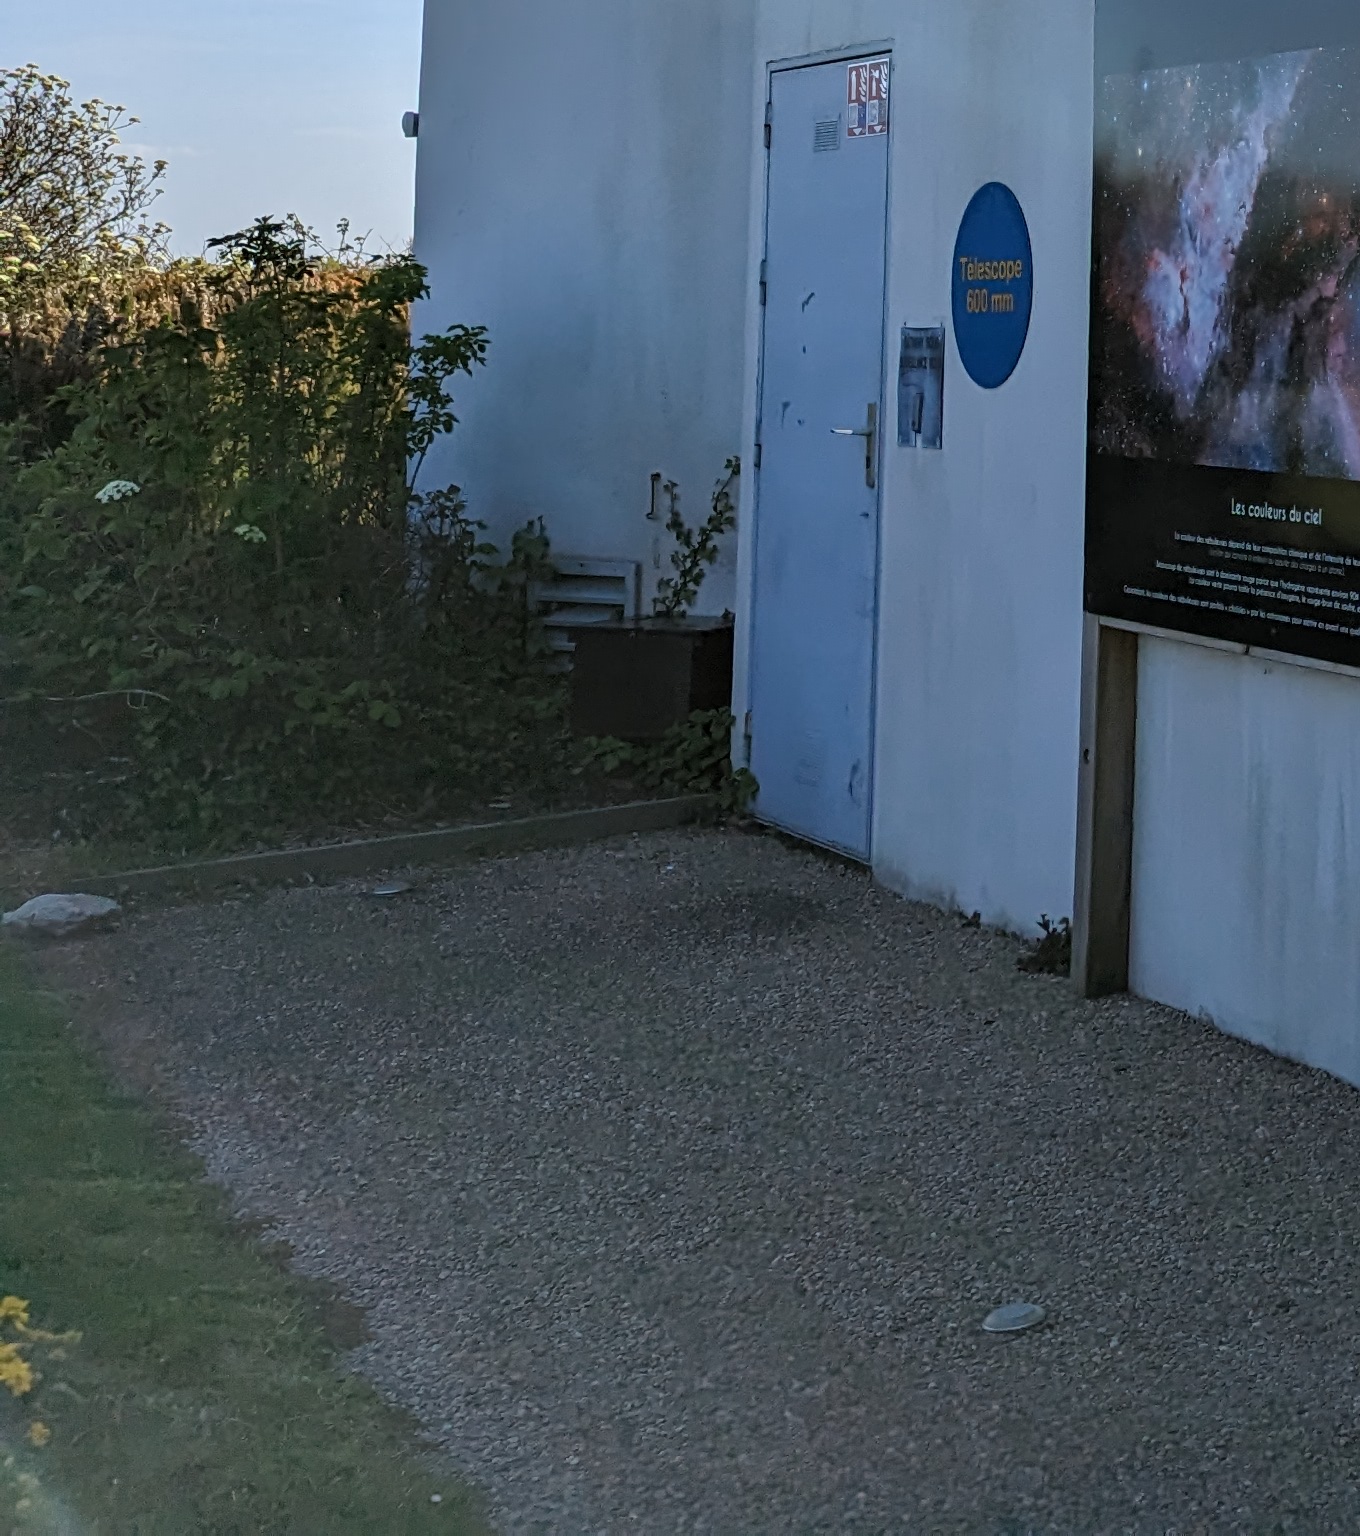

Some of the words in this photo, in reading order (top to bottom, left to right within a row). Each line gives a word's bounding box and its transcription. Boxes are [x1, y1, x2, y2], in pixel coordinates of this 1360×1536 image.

[959, 257, 1022, 283] Télescope
[966, 288, 988, 312] 600
[991, 293, 1014, 312] mm
[1231, 497, 1245, 515] Les
[1248, 502, 1286, 520] couleurs
[1288, 504, 1301, 522] du
[1303, 508, 1322, 524] ciel
